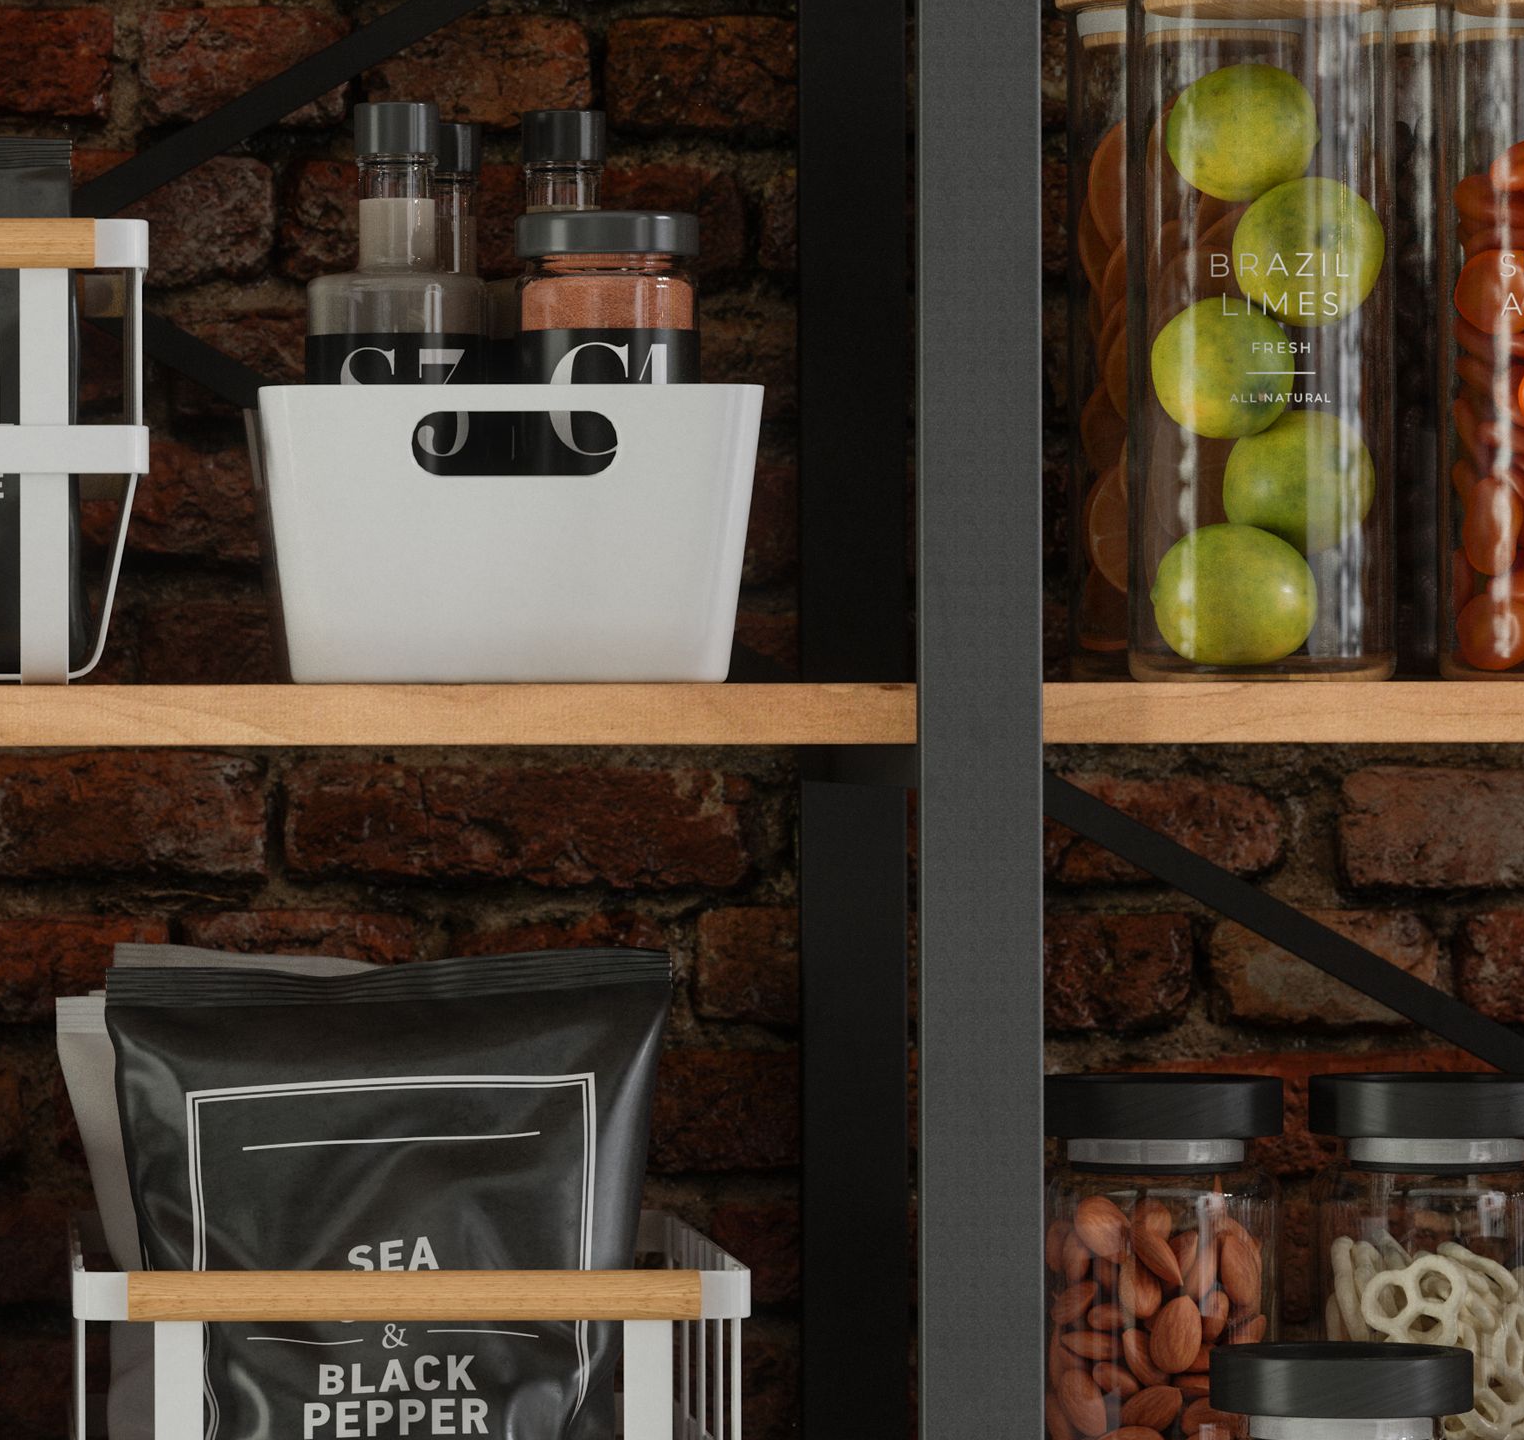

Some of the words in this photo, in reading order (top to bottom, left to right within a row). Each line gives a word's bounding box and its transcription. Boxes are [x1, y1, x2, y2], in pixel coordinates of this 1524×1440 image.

[1210, 252, 1349, 278] BRAZIL
[1222, 290, 1340, 317] LIMES
[1252, 341, 1312, 355] FRESH
[347, 1235, 440, 1271] SEA
[382, 1323, 408, 1349] &
[318, 1354, 477, 1396] BLACK
[303, 1397, 490, 1440] PEPPER
